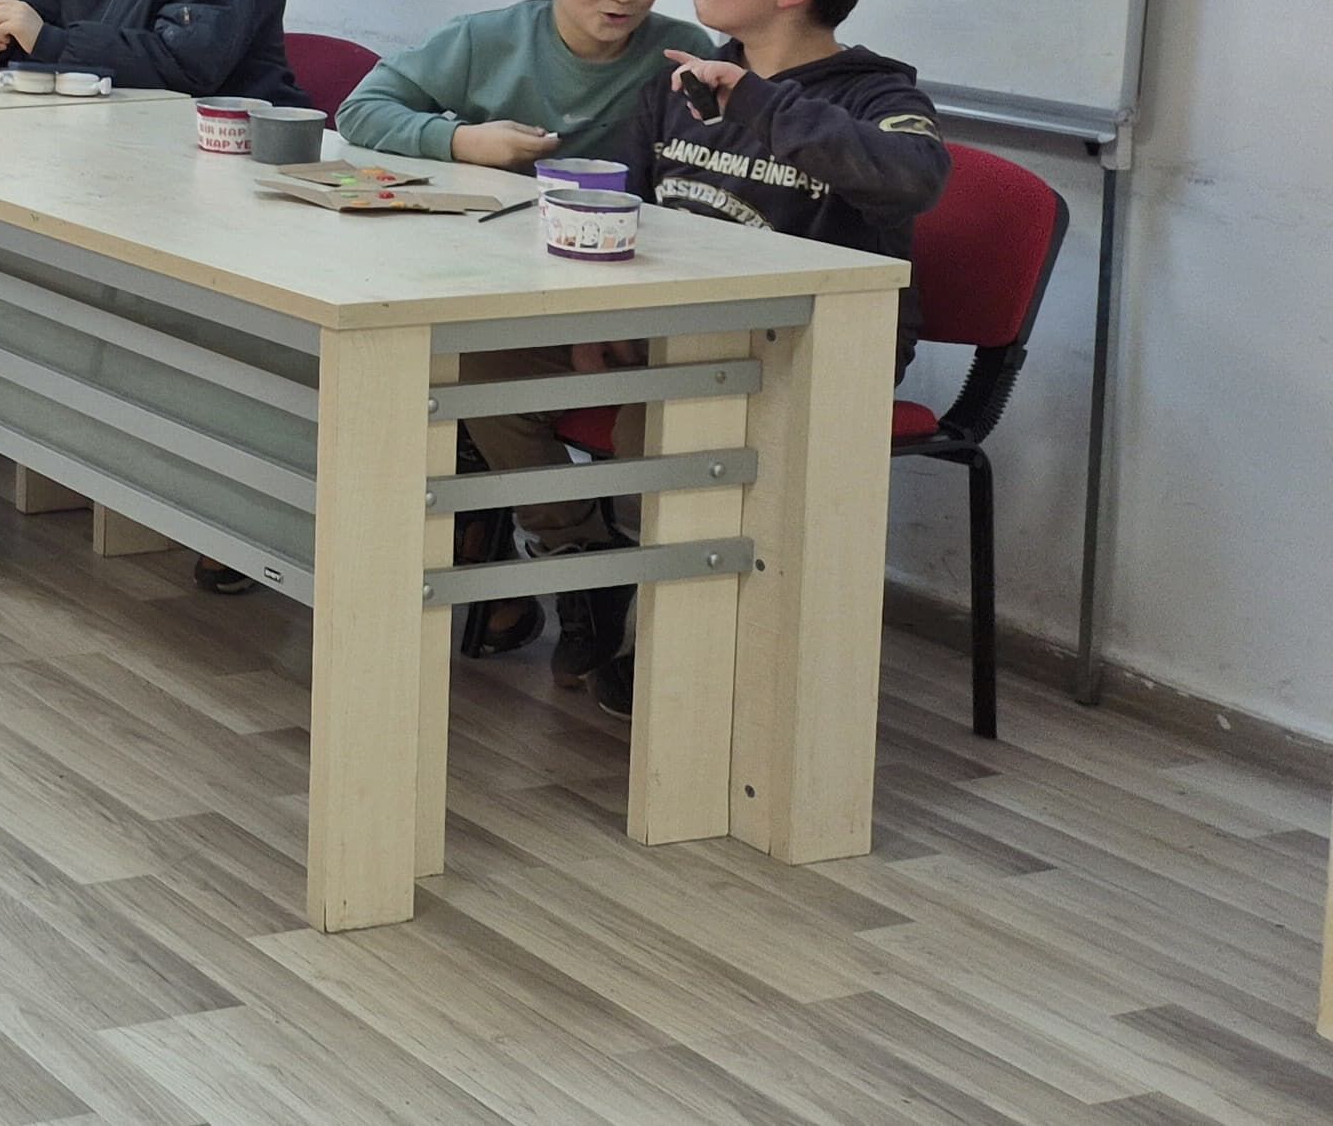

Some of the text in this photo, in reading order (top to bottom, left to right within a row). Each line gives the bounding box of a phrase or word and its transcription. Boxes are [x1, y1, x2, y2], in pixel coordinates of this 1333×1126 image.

[219, 127, 246, 137] KAP
[206, 138, 231, 149] KAP
[662, 138, 750, 178] JANDARMA
